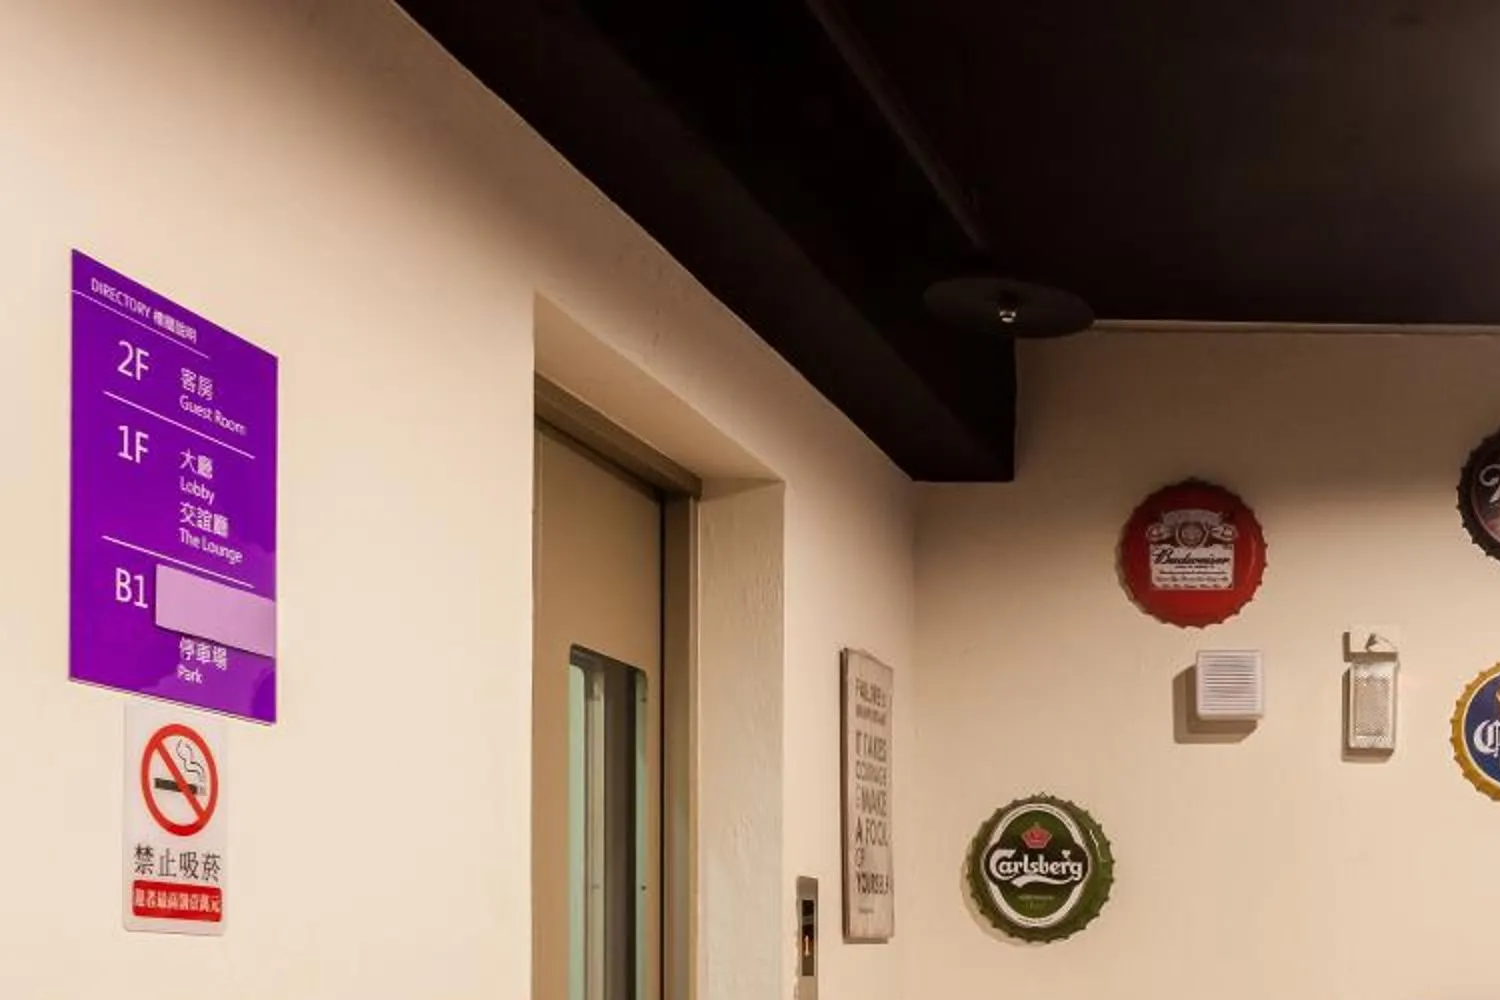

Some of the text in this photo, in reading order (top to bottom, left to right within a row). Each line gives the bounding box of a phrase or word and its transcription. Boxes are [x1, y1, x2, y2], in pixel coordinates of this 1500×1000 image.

[91, 277, 151, 318] DIRECTORY
[117, 339, 150, 381] 2F
[180, 367, 213, 401] 客房
[179, 395, 247, 436] Guest Room
[117, 425, 149, 464] 1F
[179, 476, 215, 506] Lobby
[179, 527, 243, 565] The Lounge
[116, 567, 148, 609] B1
[177, 664, 203, 684] Park
[989, 849, 1083, 888] Carlsberg
